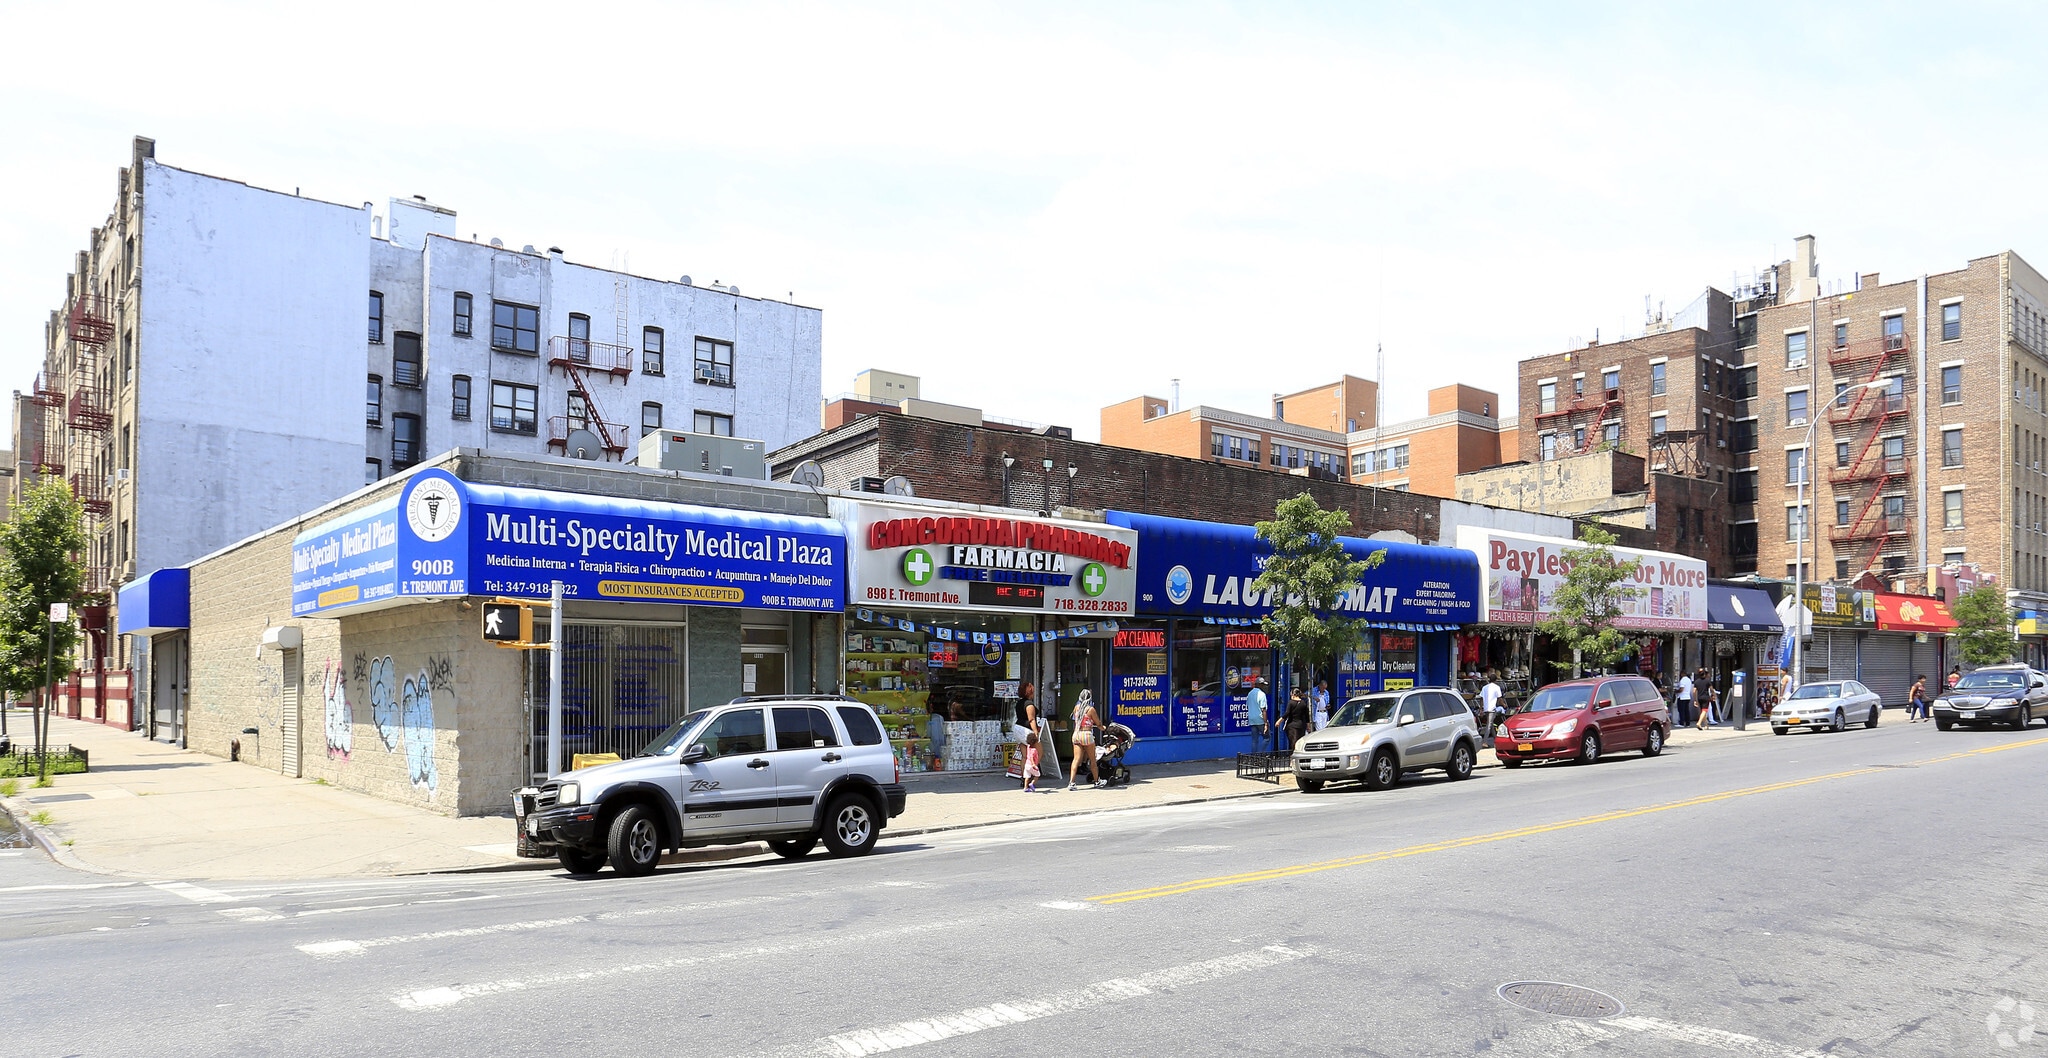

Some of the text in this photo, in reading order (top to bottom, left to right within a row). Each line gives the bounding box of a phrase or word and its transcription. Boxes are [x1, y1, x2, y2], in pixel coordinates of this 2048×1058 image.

[342, 522, 372, 559] Medical
[372, 519, 396, 550] Plaza
[486, 512, 832, 566] Multi-Specialty Medical Plaza
[870, 516, 1131, 569] CONCORDIA PHARMACY
[952, 545, 1066, 572] FARMACIA
[412, 559, 454, 576] 900B
[486, 554, 832, 587] Medicina Interna Terapia Fisica Chiropractico Acupuntura Manejo Del Dolor
[1659, 560, 1705, 589] More
[940, 566, 1073, 587] FREE DELIVERY
[402, 579, 464, 594] E. TREMONT AVE
[484, 580, 577, 595] Tel: 347-918-822
[604, 583, 739, 600] MOST INSURANCES ACCEPTED
[1423, 581, 1450, 589] ALTERATION
[762, 595, 834, 608] 900B E. TREMONT AVE
[867, 587, 961, 604] 898 E. Tremont Ave.
[1142, 594, 1153, 602] 900
[1203, 574, 1397, 613] LAUNOMAT
[1416, 589, 1456, 599] EXPERT TAILORING
[1054, 598, 1128, 612] 718.328.2833
[1402, 598, 1413, 606] DRY
[1441, 600, 1454, 608] WASH
[1490, 610, 1511, 622] HEALTH
[1113, 630, 1128, 647] DRY
[1129, 631, 1164, 647] CLEANING
[1226, 632, 1269, 649] ALTERATION
[1363, 661, 1376, 671] Fold
[1382, 661, 1415, 673] Dry Cleaning
[1120, 689, 1161, 701] Under New
[1117, 704, 1164, 718] Management
